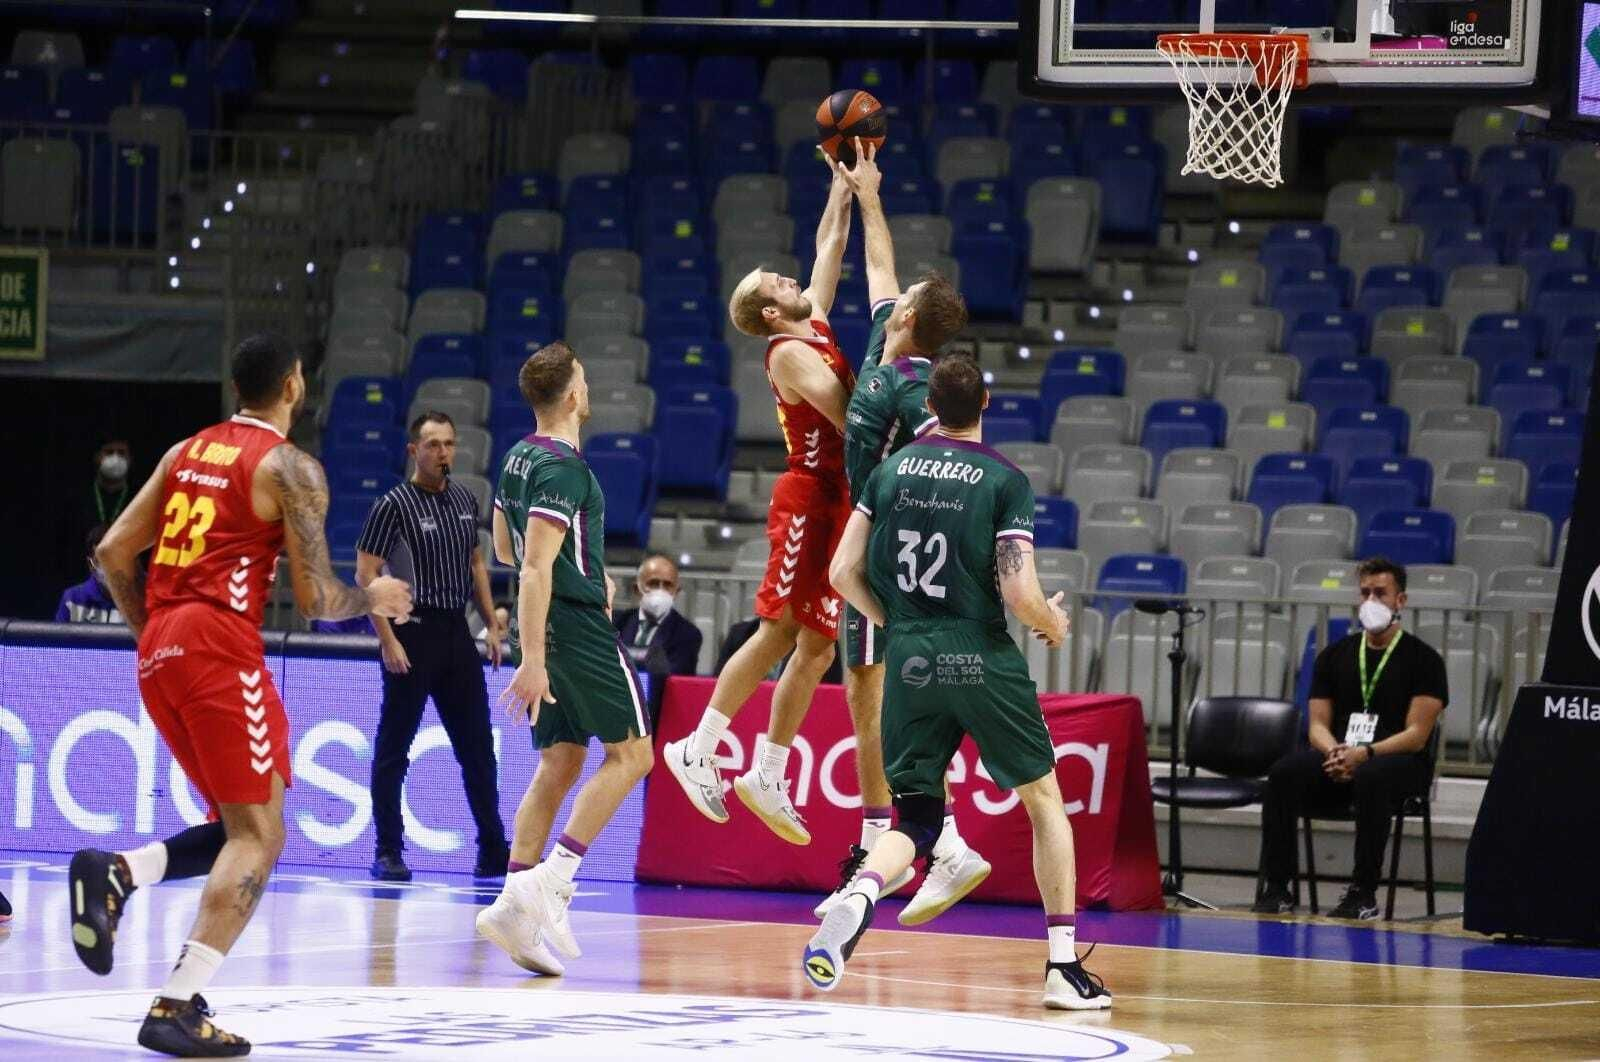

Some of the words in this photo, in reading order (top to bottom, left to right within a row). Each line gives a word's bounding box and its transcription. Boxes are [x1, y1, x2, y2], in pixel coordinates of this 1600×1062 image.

[1450, 20, 1475, 35] liga
[1450, 33, 1504, 46] endesa
[0, 308, 31, 337] CIA
[897, 457, 984, 485] GUERRERO
[154, 491, 216, 568] 23
[897, 529, 948, 598] 32
[936, 654, 984, 665] COSTA
[936, 667, 958, 676] DEL
[961, 666, 984, 675] SOL
[1544, 695, 1600, 721] Mála
